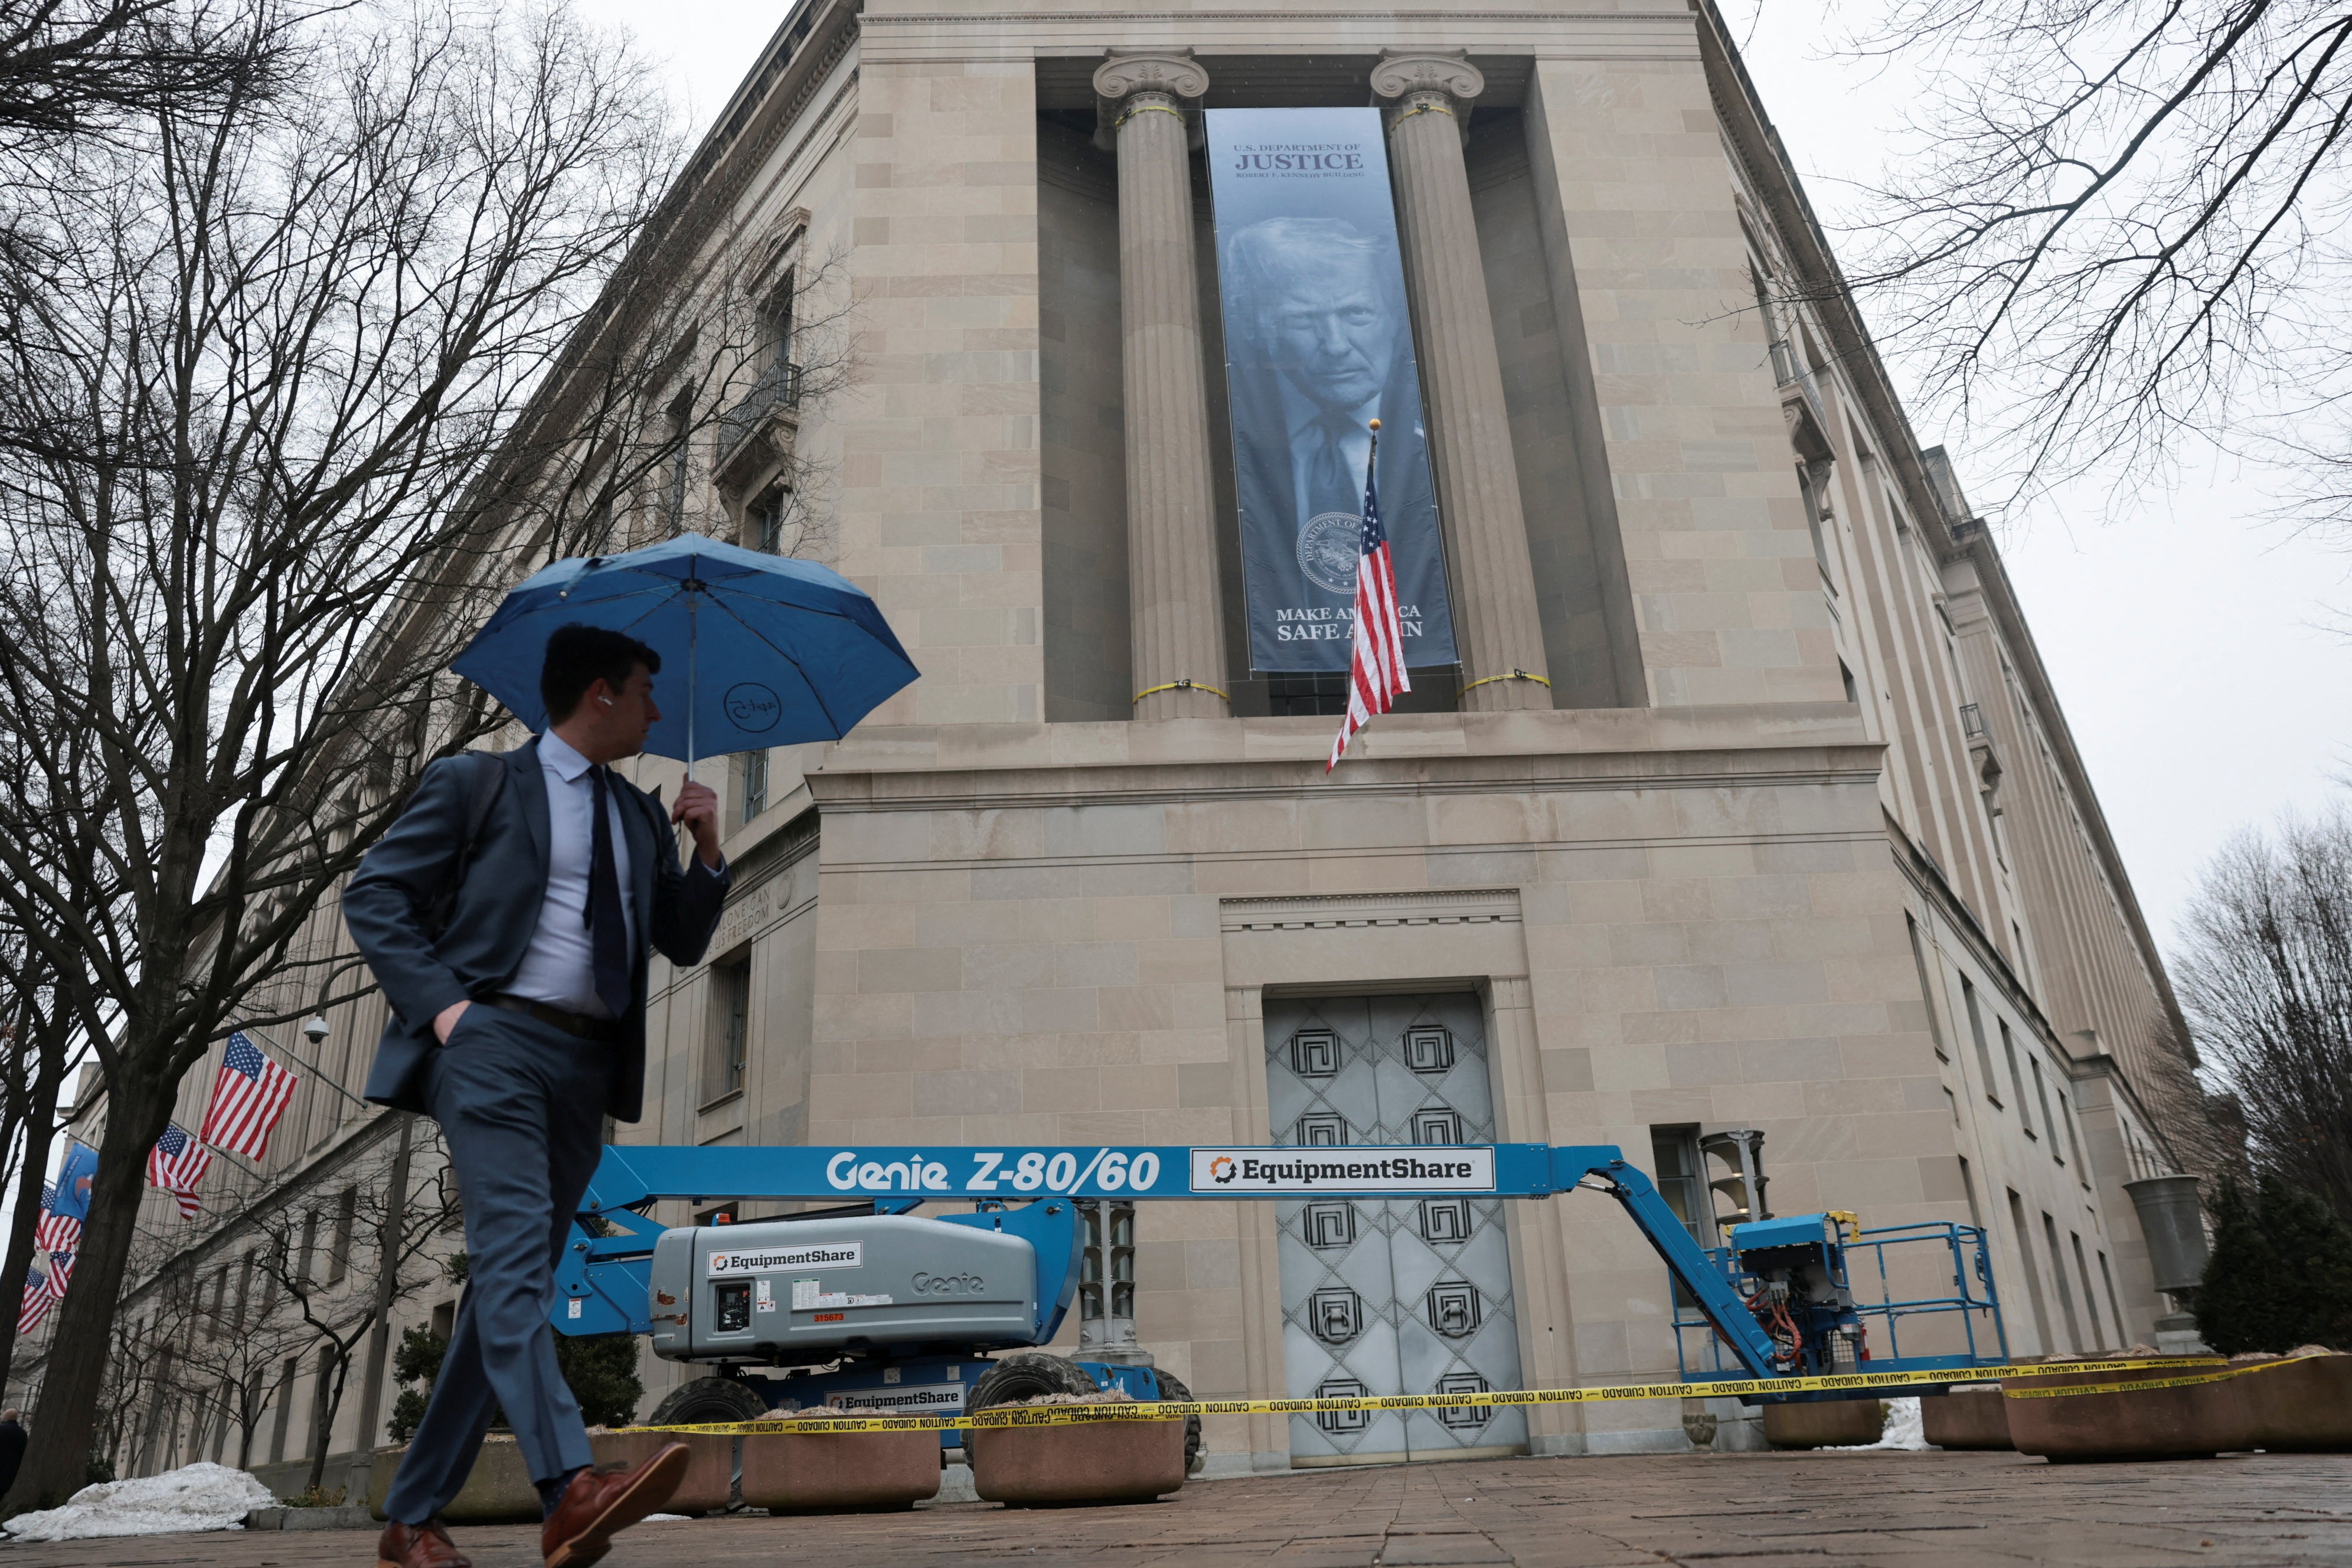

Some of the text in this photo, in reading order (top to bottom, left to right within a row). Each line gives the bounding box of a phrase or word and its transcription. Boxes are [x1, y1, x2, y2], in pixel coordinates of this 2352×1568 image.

[1260, 143, 1342, 152] DEPARTMENT
[1235, 153, 1364, 171] JUSTICE
[1305, 519, 1358, 561] DEPARTMENT OF
[1276, 607, 1332, 622] MAKE
[1277, 623, 1340, 641] SAFE
[716, 887, 770, 933] ALONE CAN
[728, 904, 769, 942] FREEDOM
[827, 1148, 1160, 1194] Genie Z-80/60
[1243, 1158, 1472, 1184] EquipmentShare
[731, 1249, 855, 1269] EquipmentShare
[911, 1272, 984, 1296] Genie
[814, 1313, 844, 1322] 315673
[1930, 1370, 1972, 1381] CUIDADO
[1977, 1368, 2018, 1378] CAUTION
[1759, 1379, 1801, 1391] CAUTION
[1821, 1376, 1863, 1387] CUIDADO
[1868, 1374, 1910, 1385] CAUTION
[1603, 1387, 1644, 1398] CUIDADO
[1650, 1385, 1692, 1396] CAUTION
[1712, 1382, 1755, 1393] CUIDADO
[846, 1391, 959, 1409] EquipmentShare
[1428, 1395, 1472, 1406] CAUTION
[1492, 1392, 1534, 1403] CUIDADO
[1539, 1390, 1582, 1401] CAUTION
[1270, 1401, 1312, 1411] CUIDADO
[1317, 1399, 1360, 1409] CAUTION
[1381, 1397, 1423, 1407] CUIDADO
[1047, 1405, 1090, 1416] CUIDADO
[1095, 1405, 1137, 1415] CAUTION
[1158, 1403, 1201, 1414] CUIDADO
[1206, 1403, 1249, 1413] CAUTION
[833, 1420, 866, 1430] CAUTION
[883, 1419, 916, 1429] CUIDADO
[920, 1418, 955, 1428] CAUTION
[972, 1416, 1007, 1426] CUIDADO
[1012, 1414, 1051, 1426] CAUTION
[737, 1423, 754, 1433] CUIDADO
[756, 1422, 783, 1432] CAUTION
[798, 1421, 829, 1431] CUIDADO
